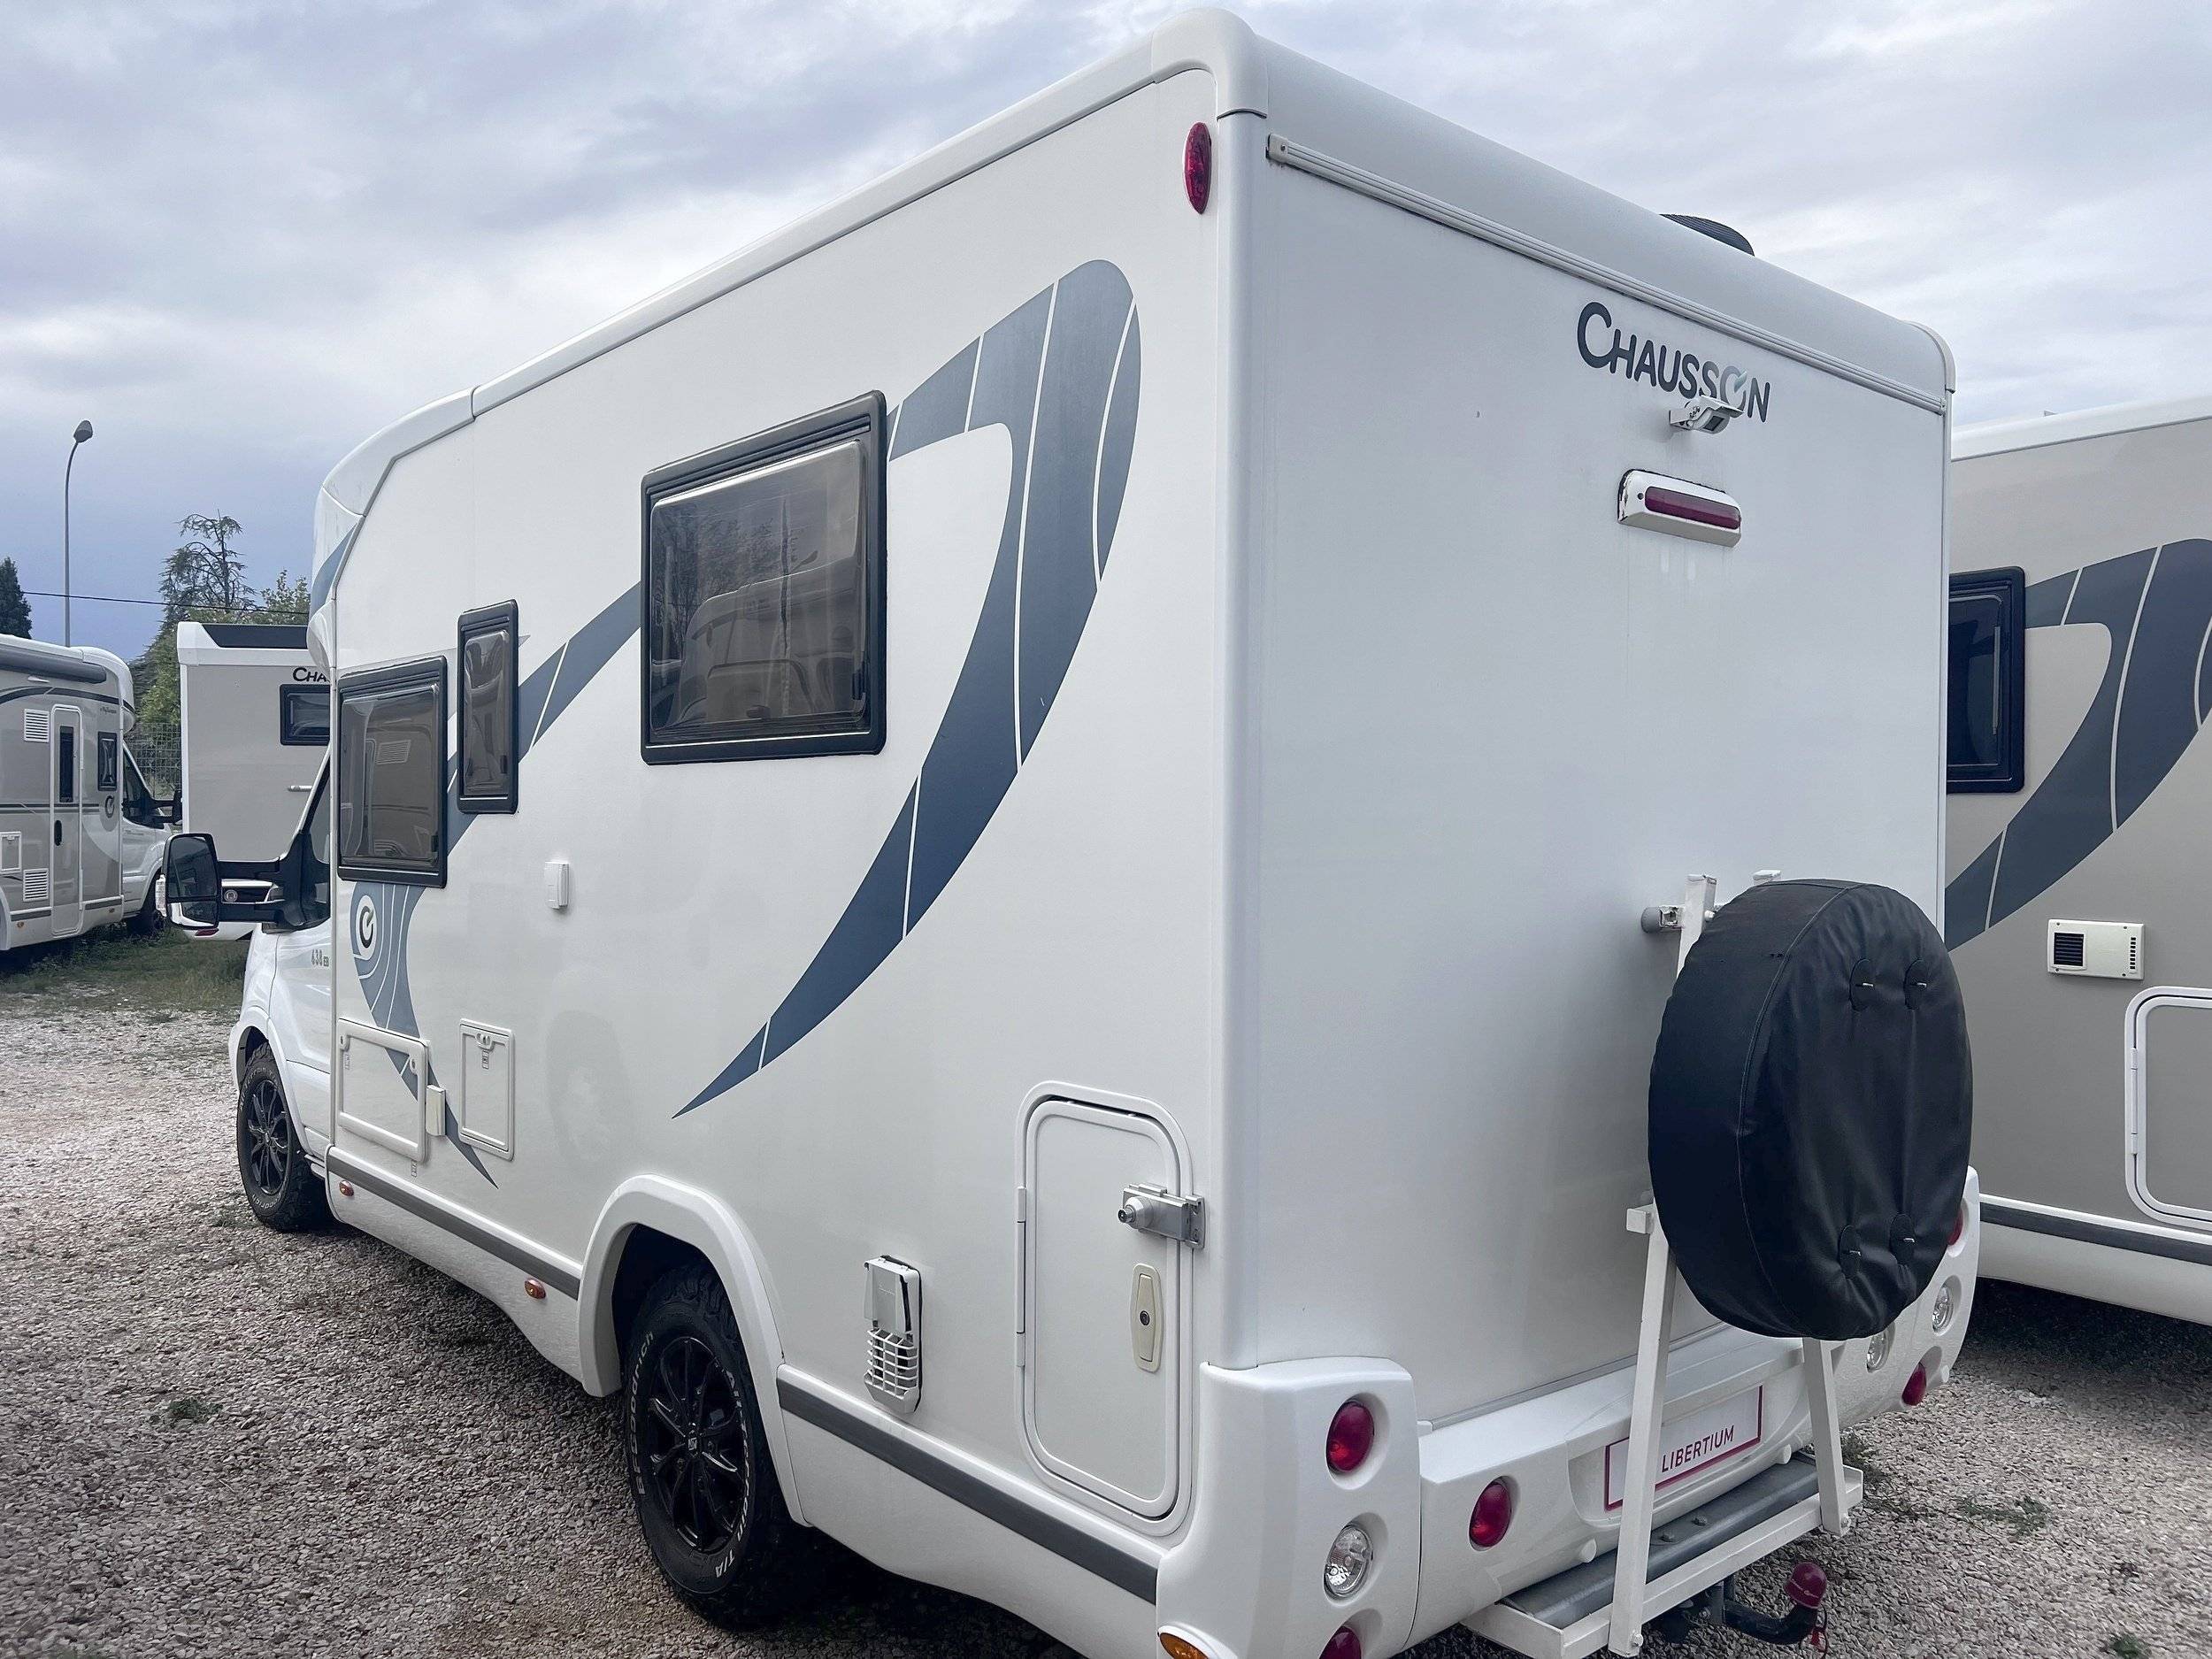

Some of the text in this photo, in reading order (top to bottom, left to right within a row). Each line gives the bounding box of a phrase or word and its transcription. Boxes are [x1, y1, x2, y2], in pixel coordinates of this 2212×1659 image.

[1577, 302, 1770, 422] CHAUSSON
[293, 666, 331, 682] CHA
[1662, 1425, 1734, 1472] LIBERTIUM
